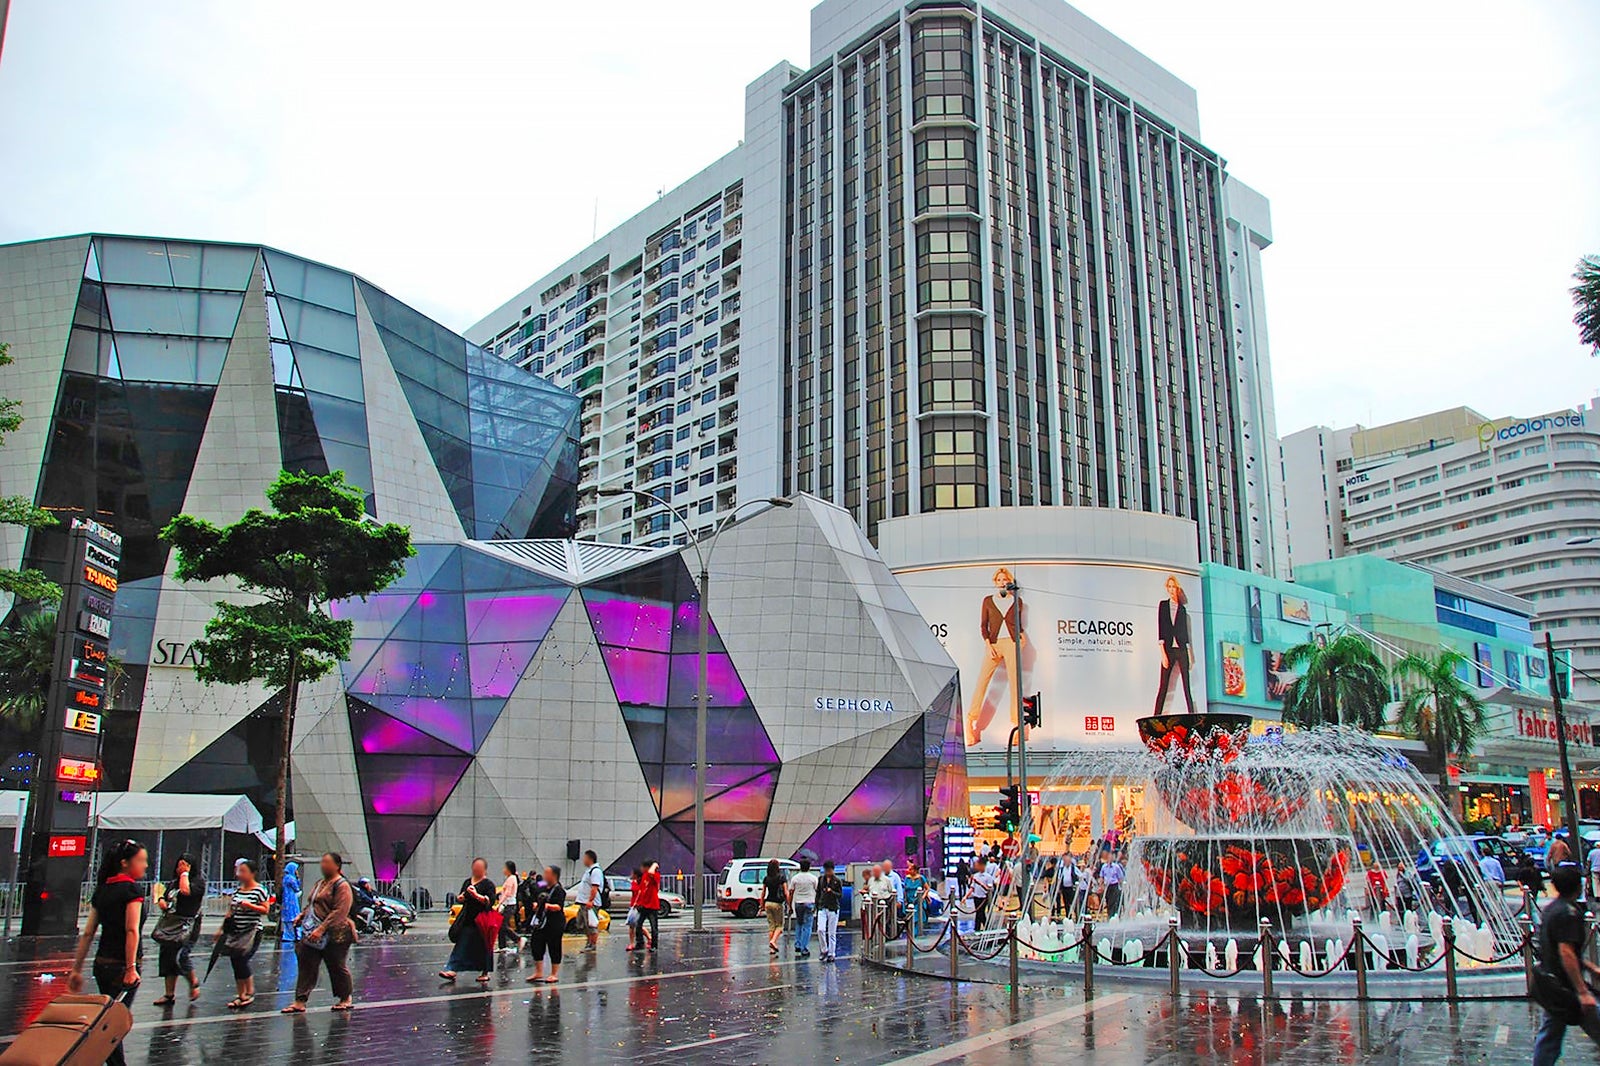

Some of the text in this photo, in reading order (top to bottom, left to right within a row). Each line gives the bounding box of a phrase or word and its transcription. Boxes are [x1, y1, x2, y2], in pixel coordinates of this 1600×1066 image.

[1346, 473, 1369, 486] HOTEL
[86, 565, 117, 593] TANGS
[1057, 620, 1134, 637] RECARGOS
[1057, 637, 1085, 646] Simple,
[816, 697, 894, 712] SEPHORA
[1517, 708, 1590, 744] fahreheit
